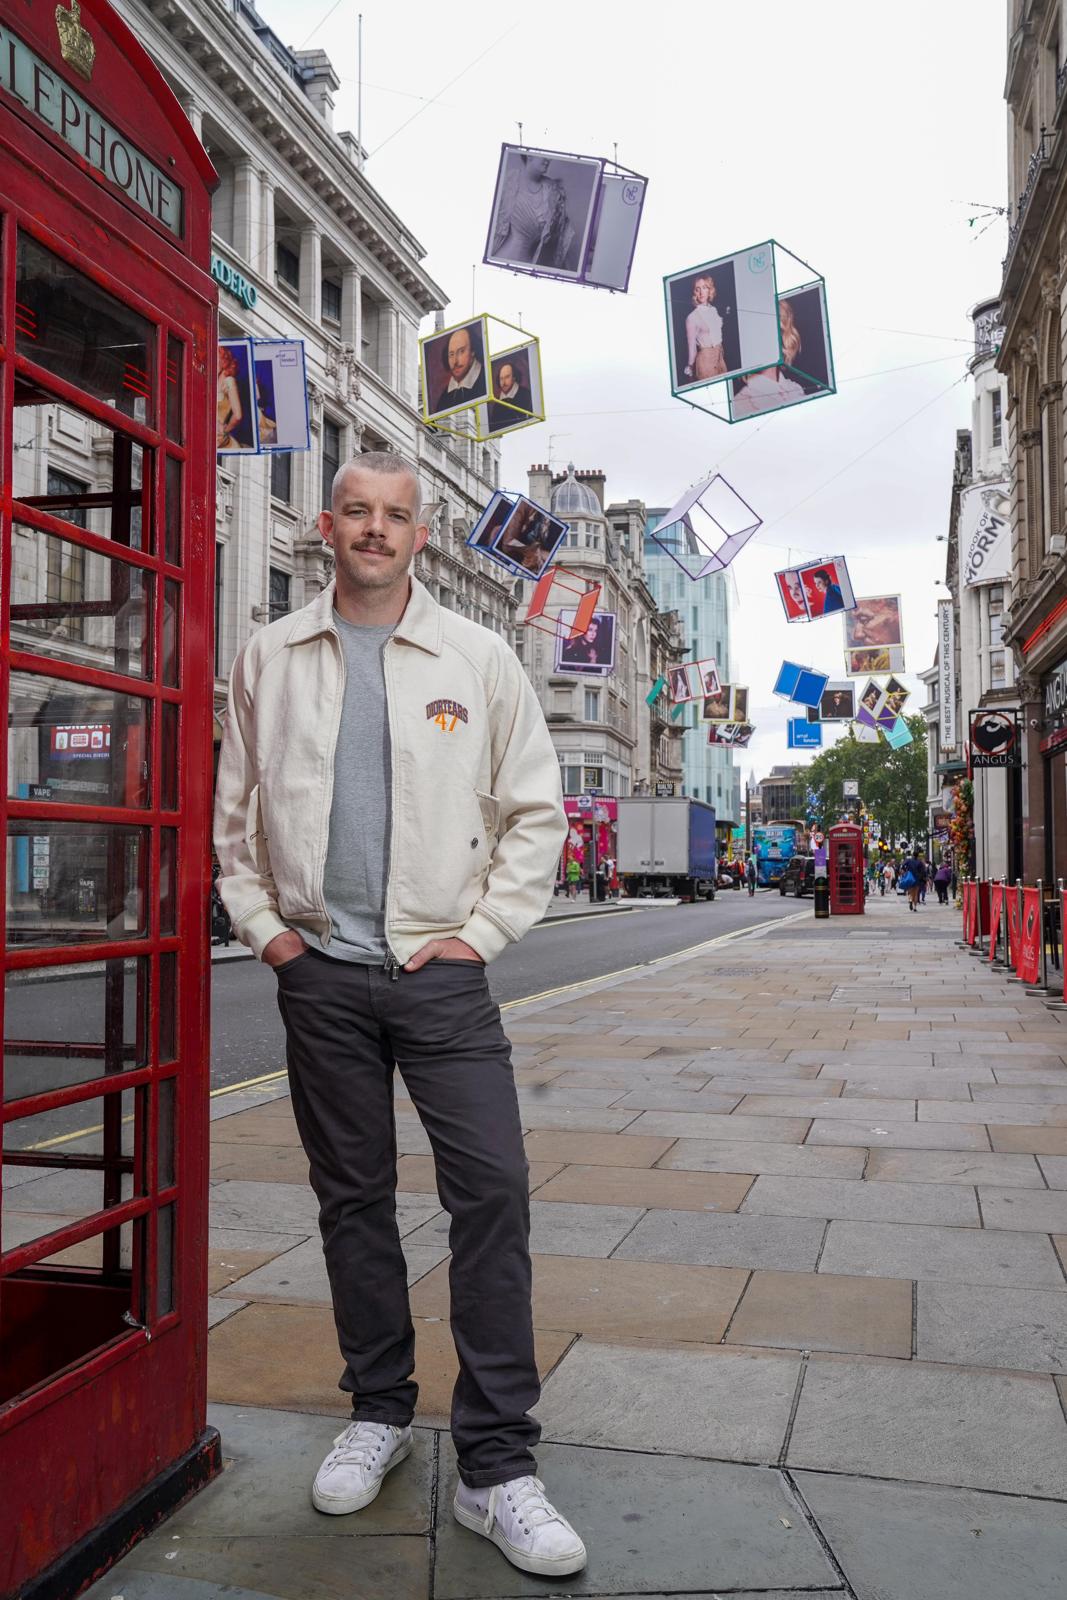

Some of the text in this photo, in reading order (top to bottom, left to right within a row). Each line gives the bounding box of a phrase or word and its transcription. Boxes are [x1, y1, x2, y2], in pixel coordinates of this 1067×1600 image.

[0, 31, 173, 229] LEPHONE
[967, 528, 982, 559] BOOK
[980, 512, 989, 527] OF
[942, 608, 950, 643] CENTURY
[944, 660, 950, 671] OF
[1045, 671, 1067, 717] ANGU
[434, 711, 458, 732] 47
[974, 755, 1014, 764] ANGUS
[33, 788, 51, 797] VAPE
